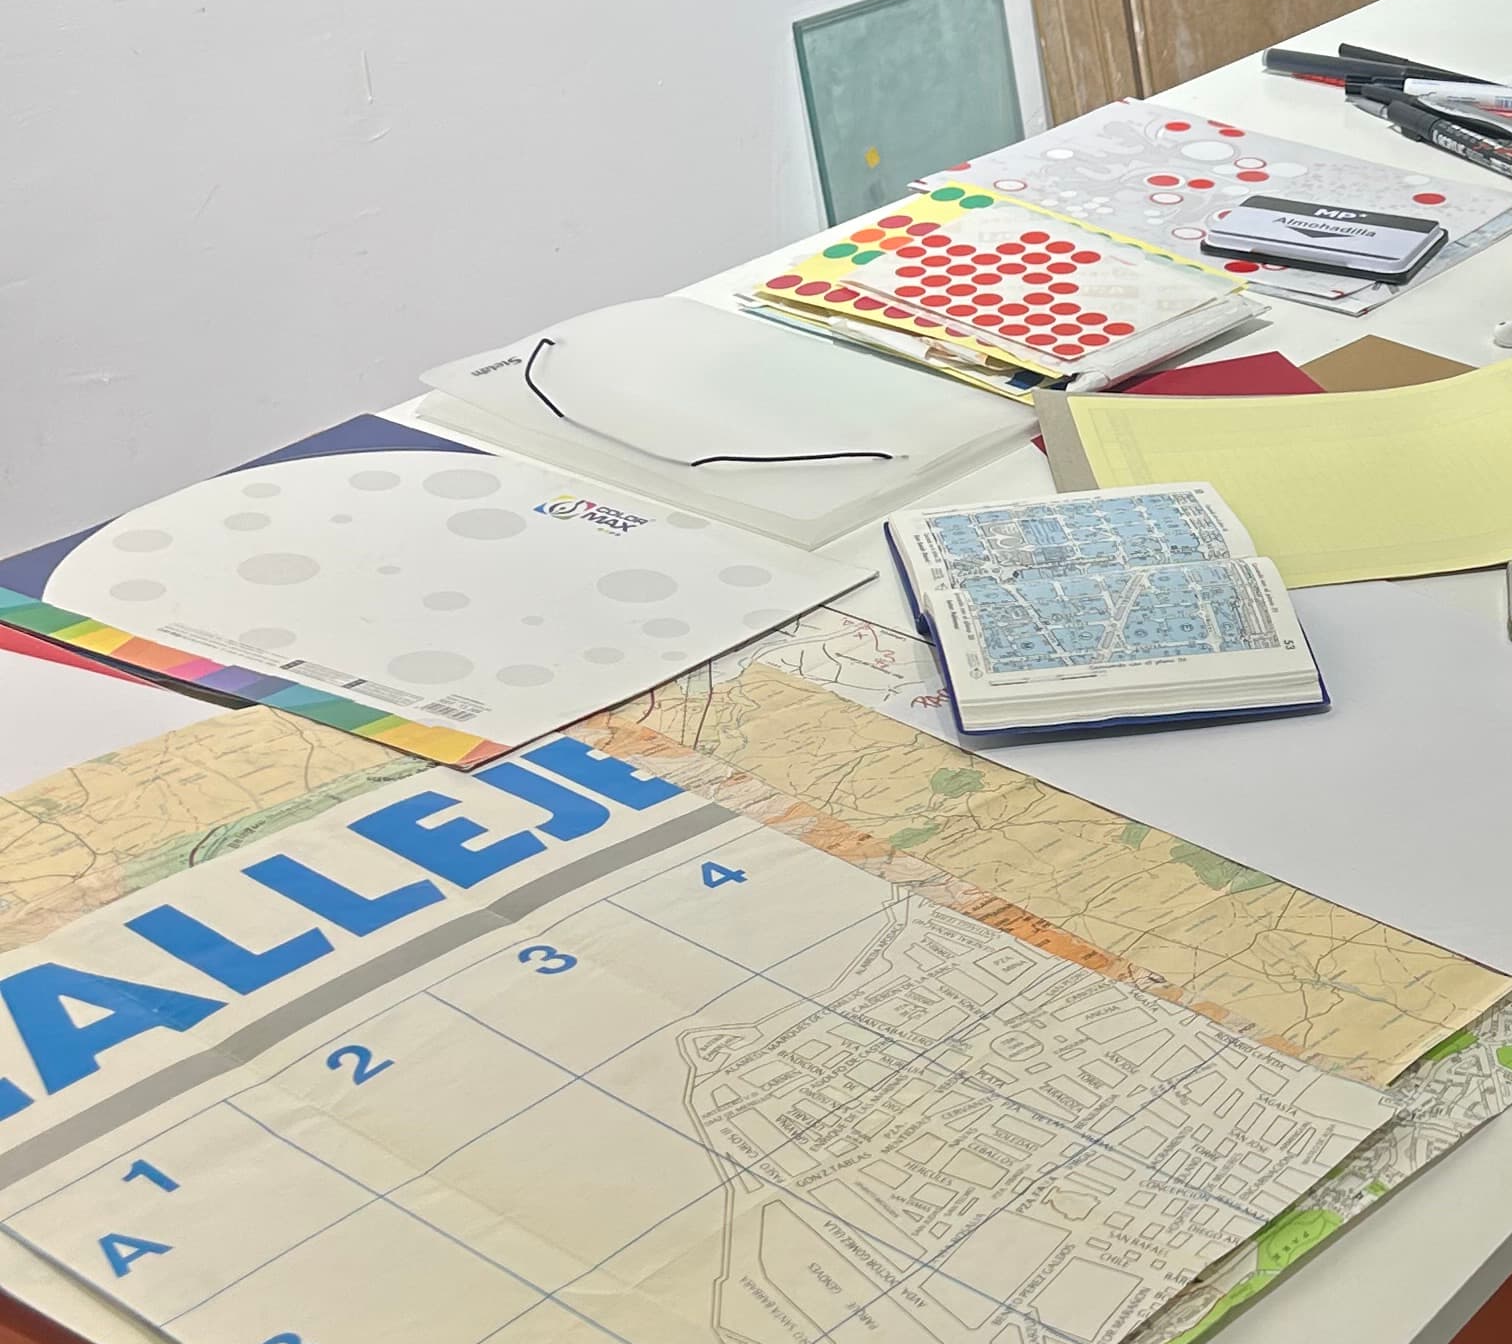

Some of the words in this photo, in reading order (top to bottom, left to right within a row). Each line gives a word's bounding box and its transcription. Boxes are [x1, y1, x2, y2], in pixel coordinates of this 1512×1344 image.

[1272, 216, 1376, 237] Almohadilla
[581, 511, 637, 532] MAX
[596, 506, 648, 525] COLOR
[700, 859, 749, 891] 4
[0, 734, 688, 1121] ALLEJE
[516, 944, 579, 976] 3
[324, 1043, 396, 1087] 2
[1256, 1092, 1299, 1118] SAGASTA
[121, 1158, 181, 1194] 1
[1109, 1230, 1130, 1245] SAN
[97, 1230, 174, 1279] A
[1100, 1252, 1130, 1269] CHILE
